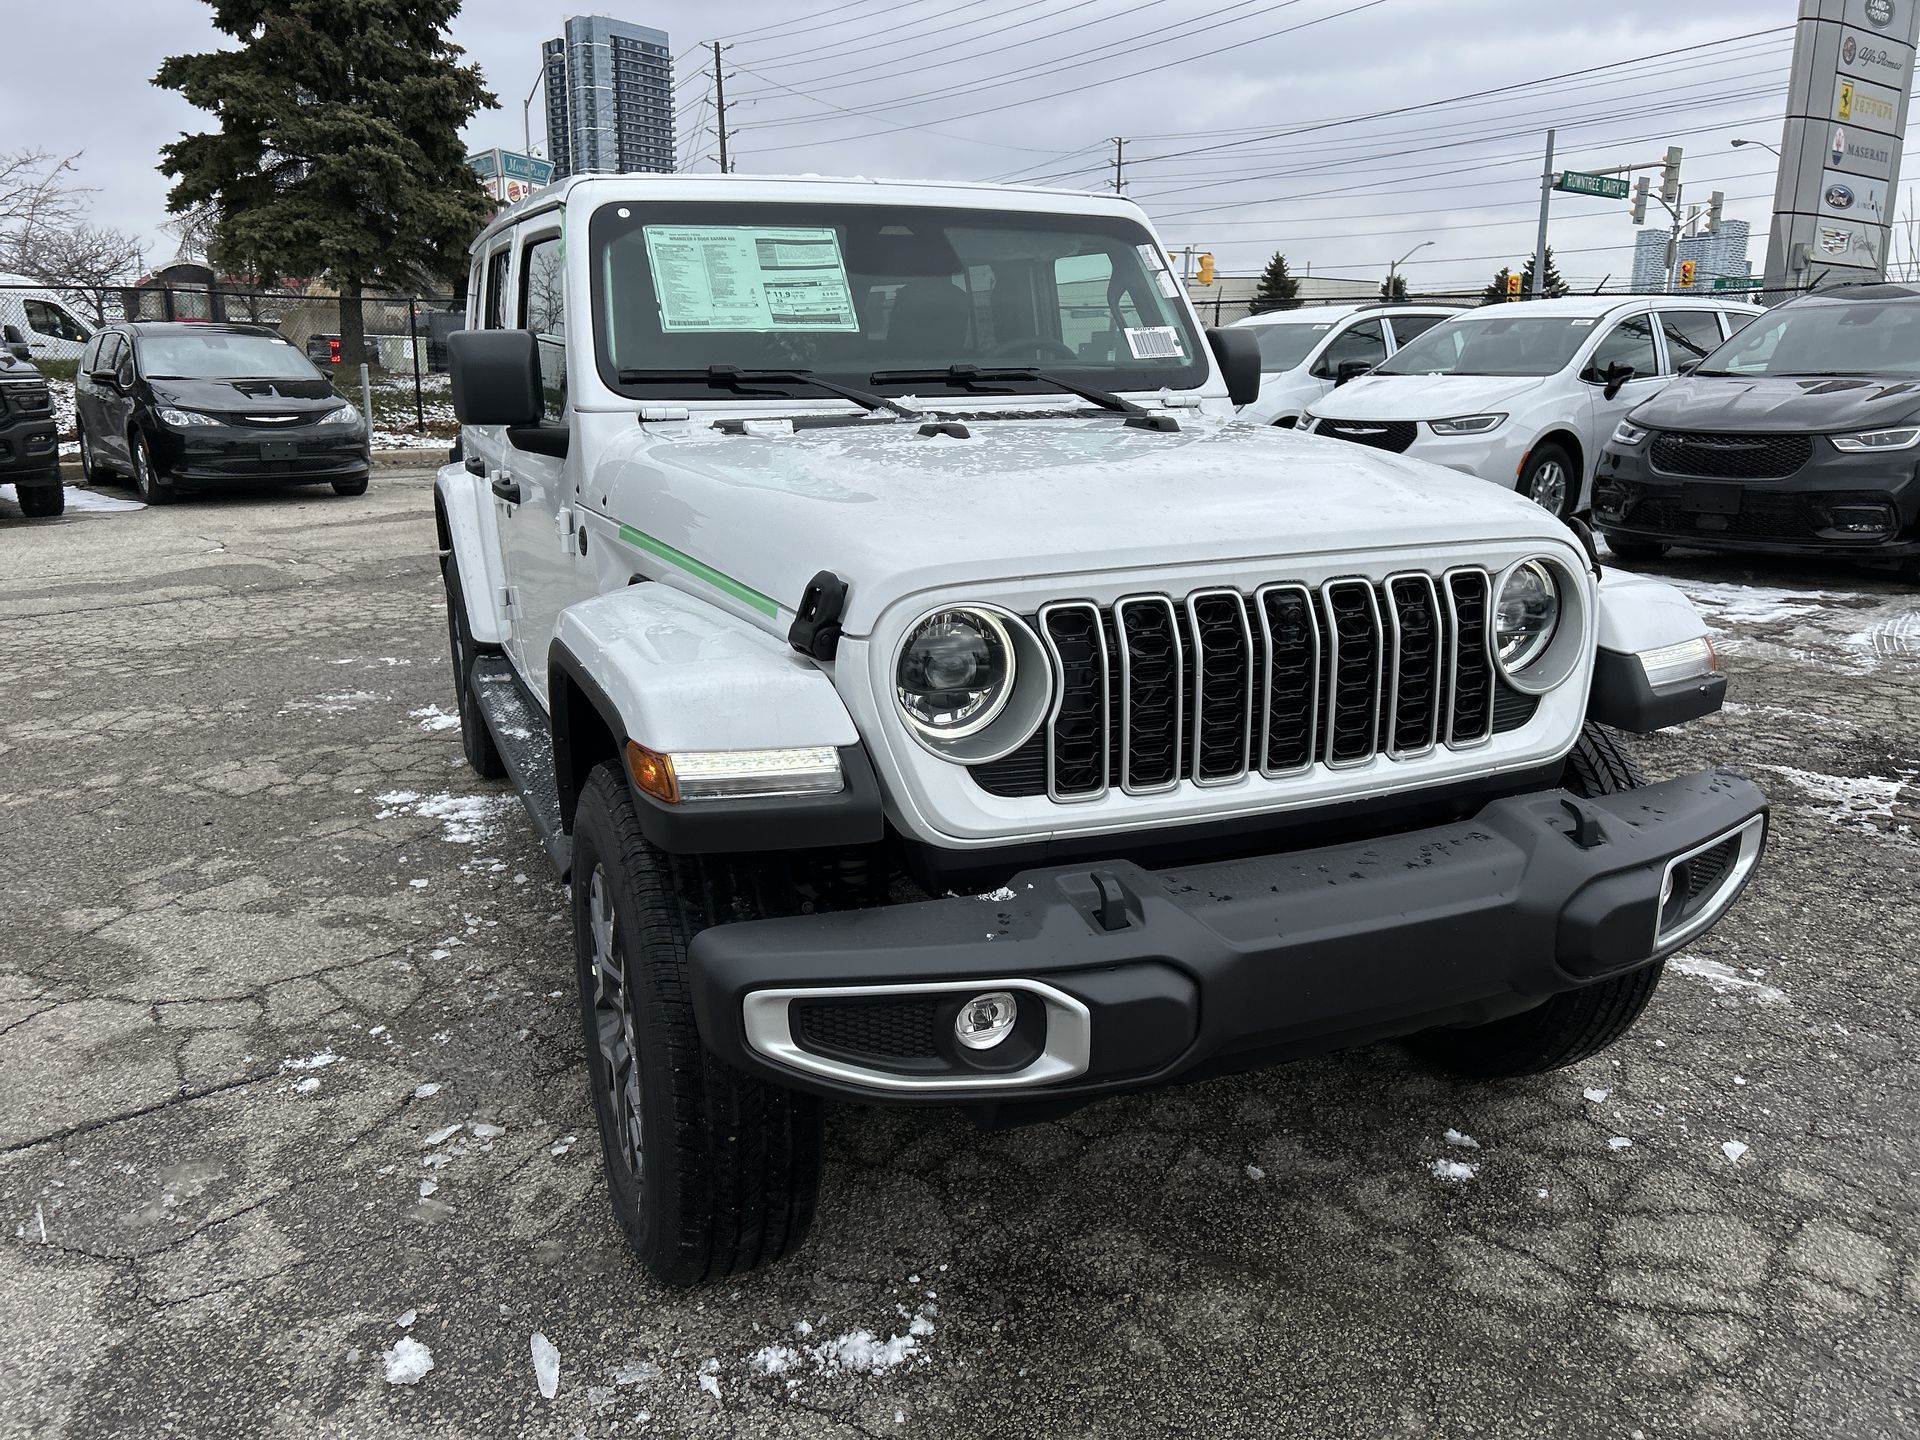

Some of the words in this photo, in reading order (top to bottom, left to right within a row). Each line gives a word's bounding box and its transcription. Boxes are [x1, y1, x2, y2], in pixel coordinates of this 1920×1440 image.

[1846, 143, 1889, 163] MASERATI
[1566, 173, 1601, 191] ROWNTREE
[1602, 179, 1621, 194] DAIRY
